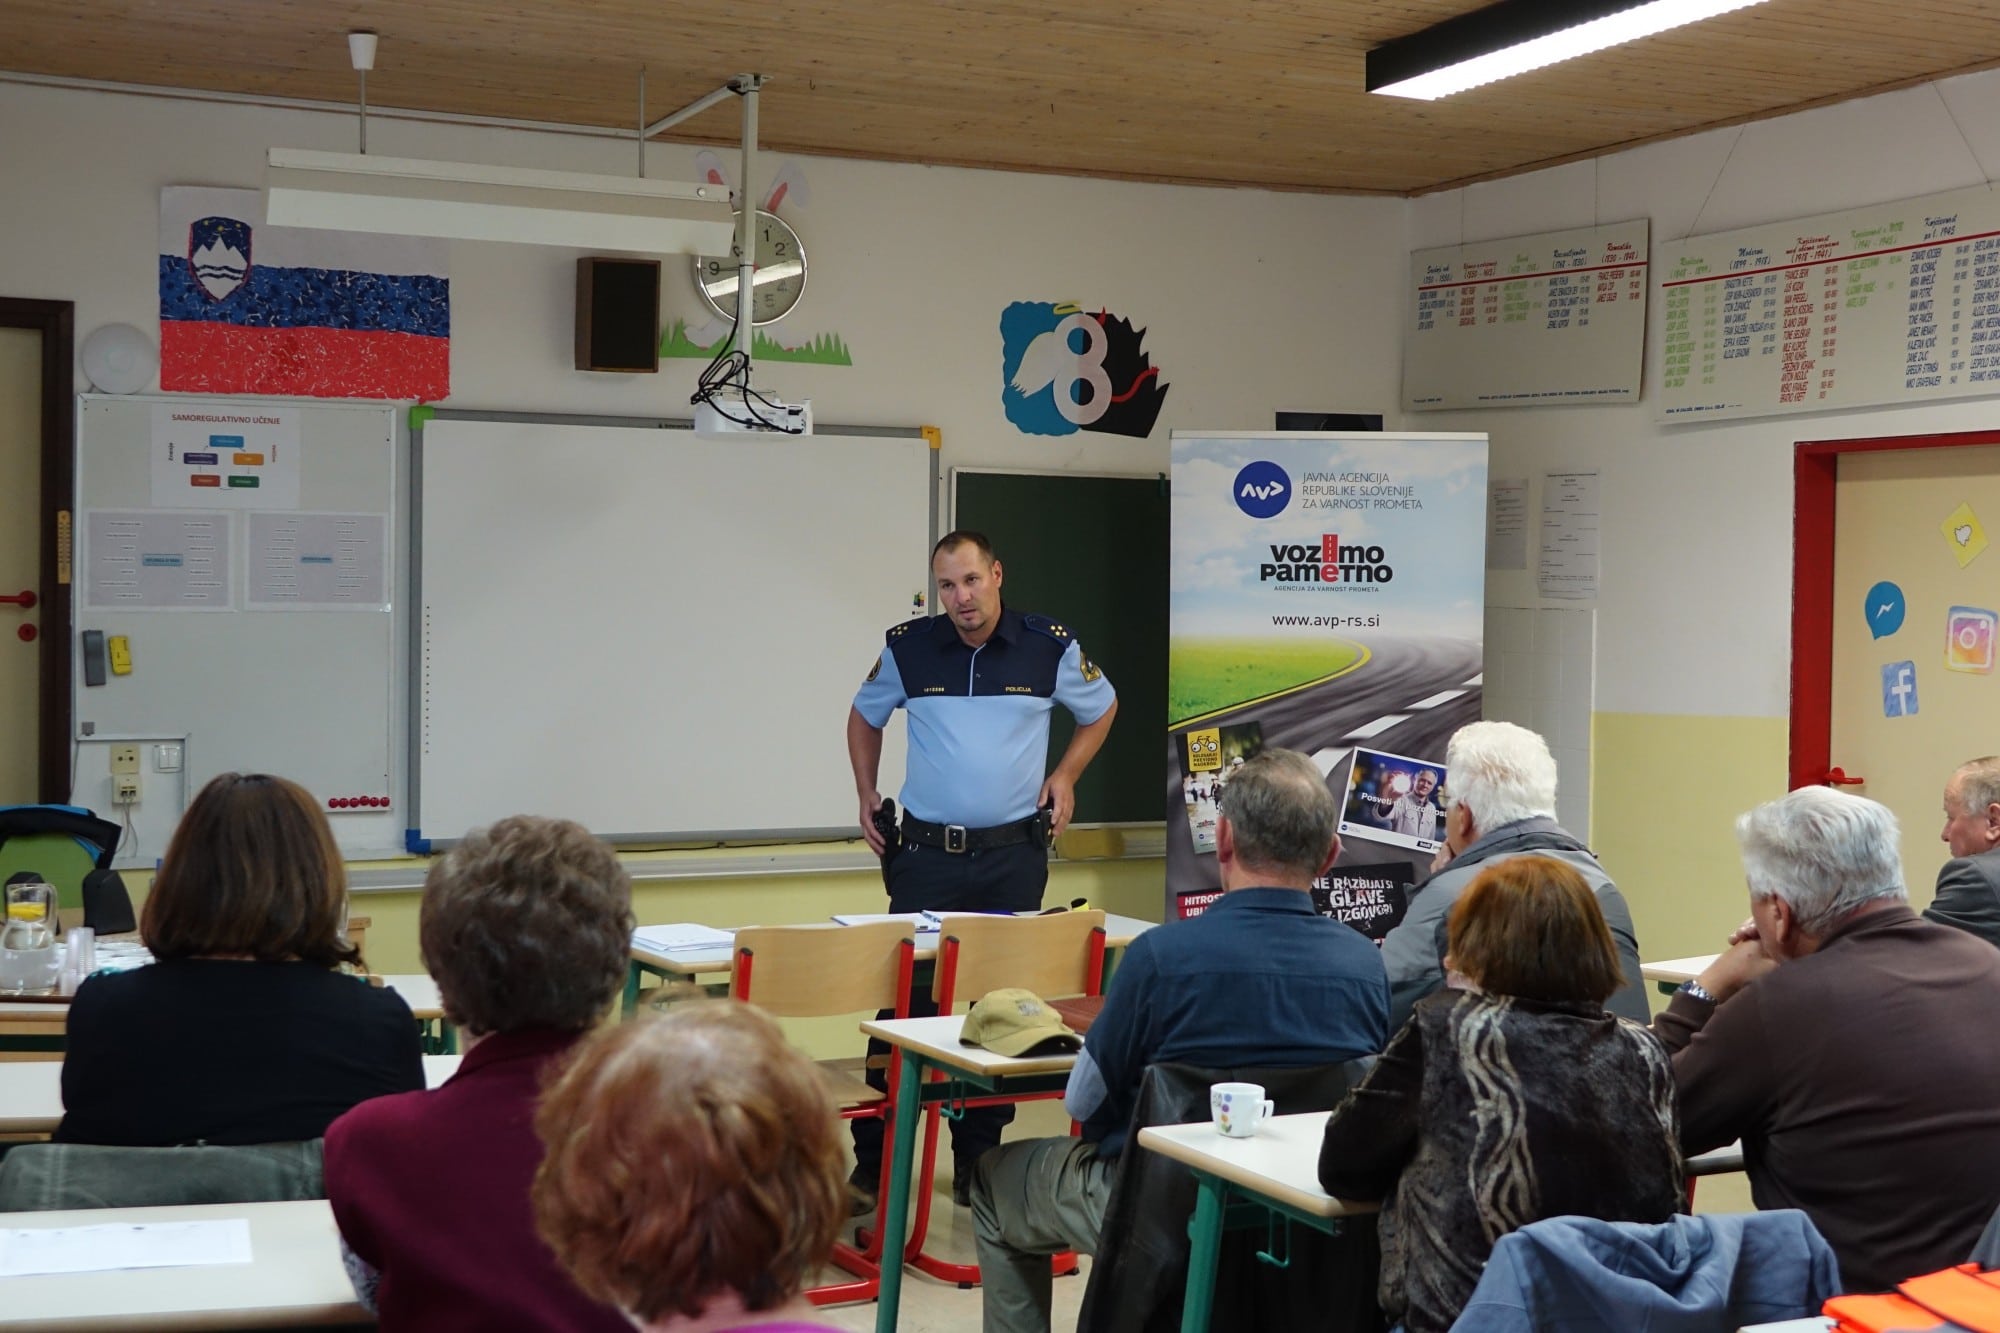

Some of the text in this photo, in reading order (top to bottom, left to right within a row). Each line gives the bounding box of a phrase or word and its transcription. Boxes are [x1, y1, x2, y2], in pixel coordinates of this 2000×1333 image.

[775, 243, 785, 256] 2
[172, 414, 281, 424] SAMOREGULATIVNO UČENJE
[1302, 473, 1390, 485] JAVNA AGENCIJA
[1302, 486, 1414, 498] REPUBLIKE SLOVENIJE
[1302, 499, 1424, 510] ZA VARNOST PROMETA
[1272, 614, 1380, 629] www.avp-rs.si
[1361, 792, 1392, 806] Posveti
[1311, 878, 1330, 889] NE
[1333, 876, 1384, 889] RAZBIJAJ
[1330, 889, 1385, 908] GLAVE
